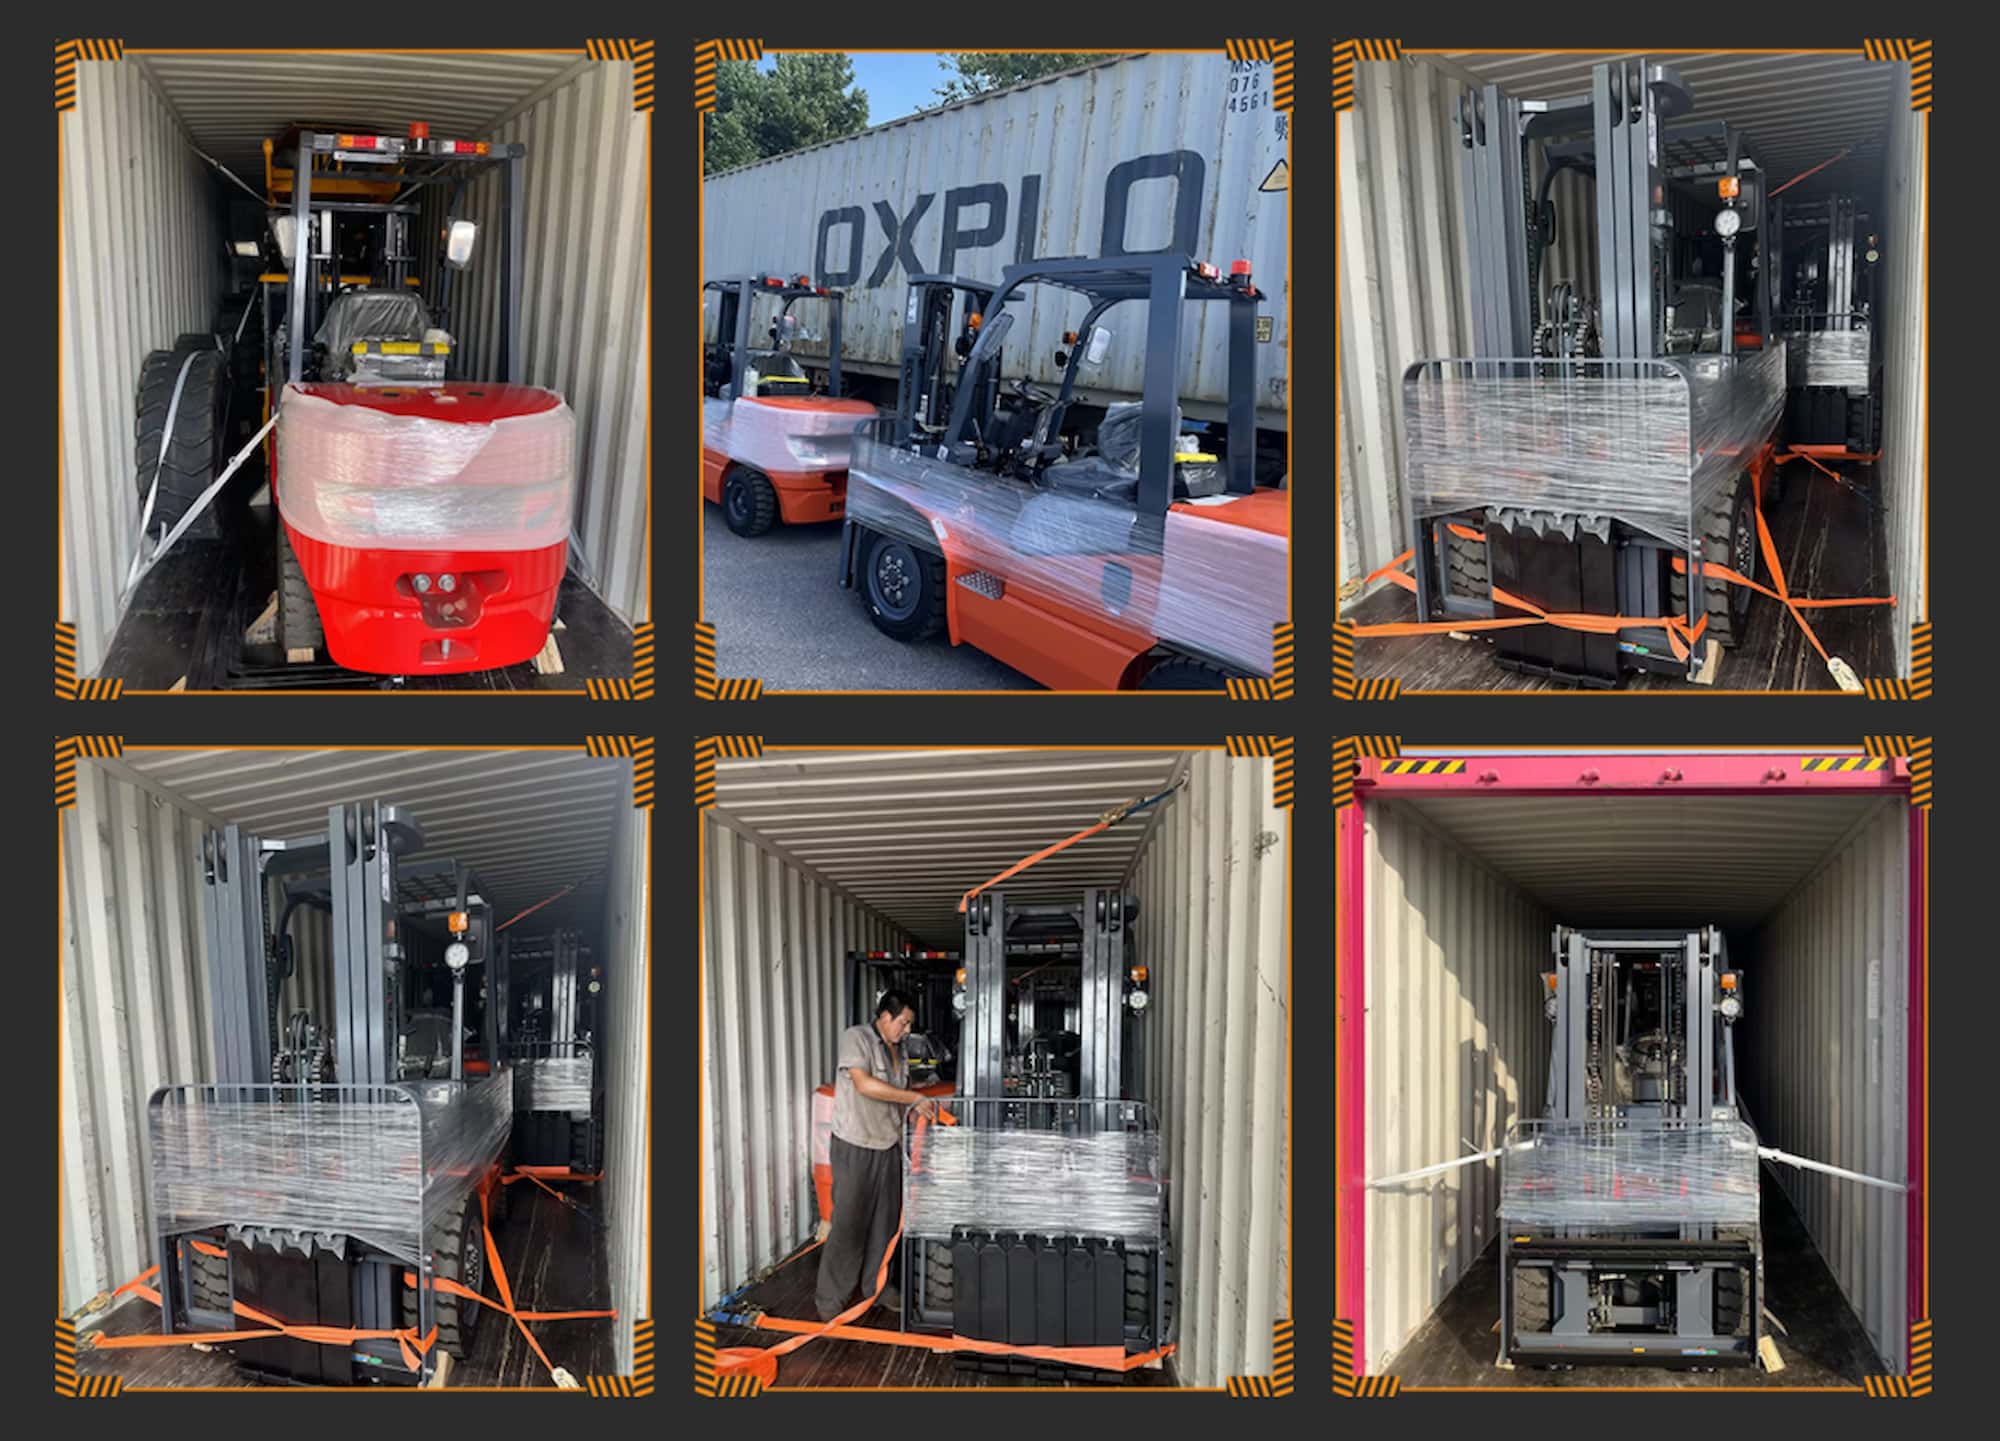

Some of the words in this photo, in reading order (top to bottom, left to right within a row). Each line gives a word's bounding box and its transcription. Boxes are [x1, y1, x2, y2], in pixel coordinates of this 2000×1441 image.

[1230, 73, 1259, 93] 076
[1228, 91, 1267, 112] 4561
[815, 150, 1206, 288] OXPLO
